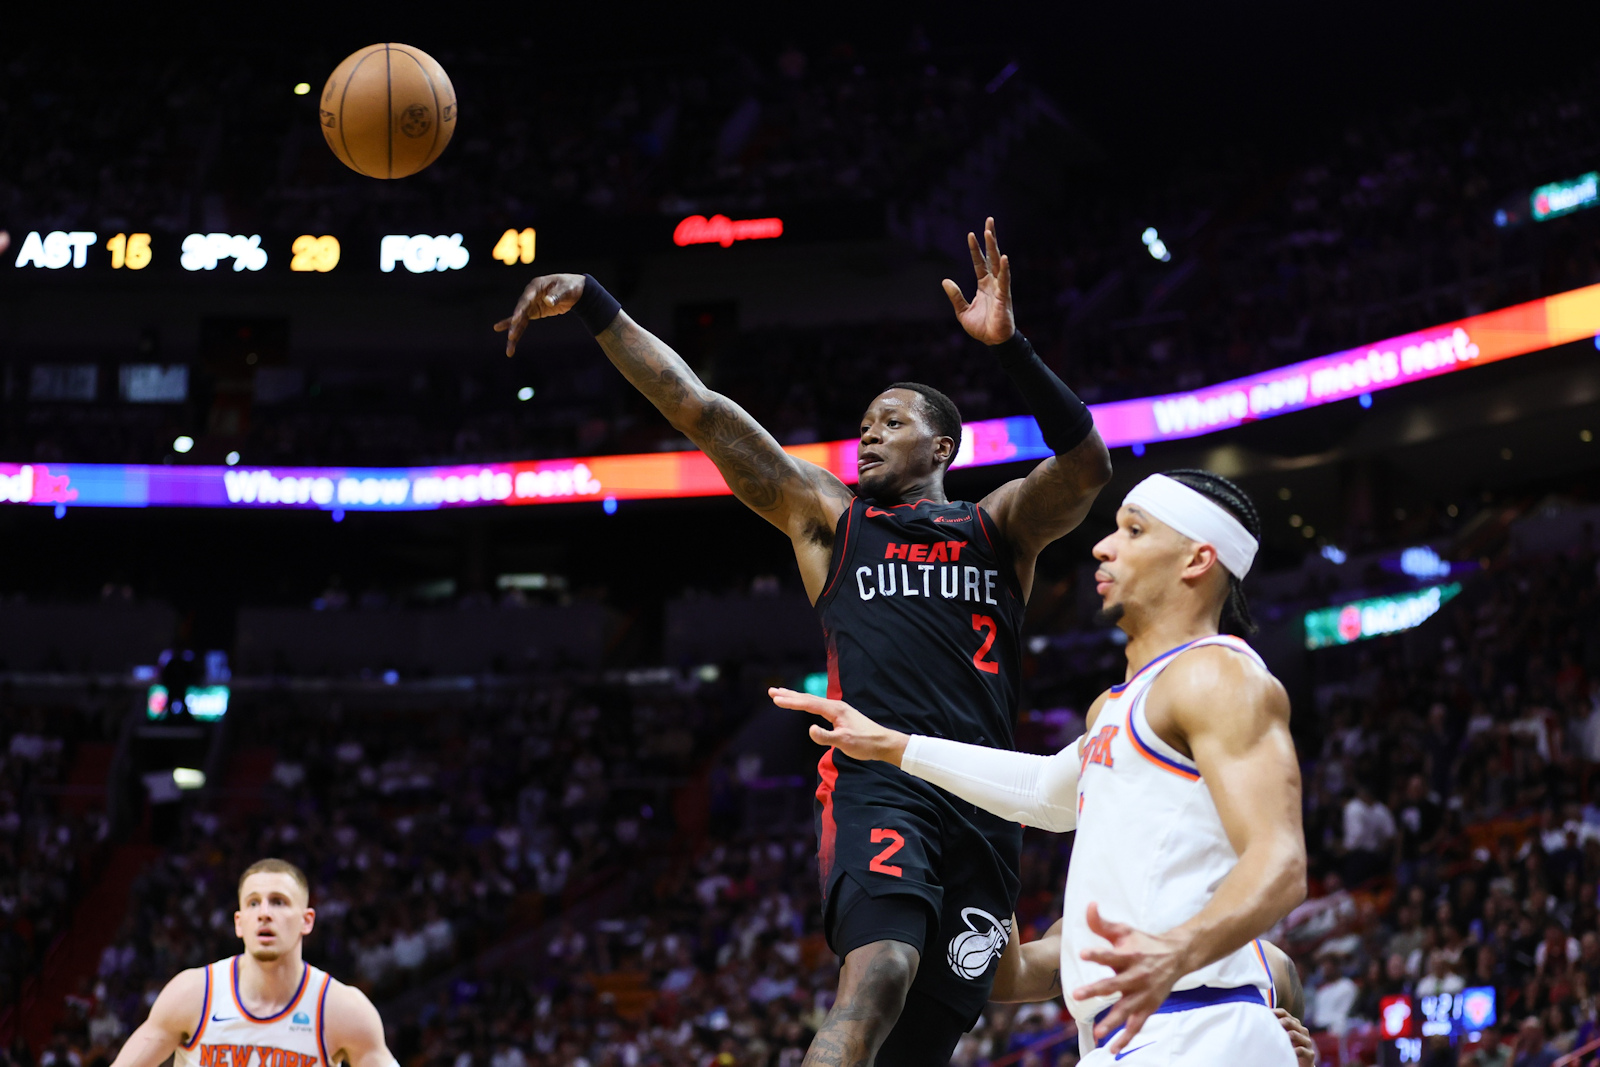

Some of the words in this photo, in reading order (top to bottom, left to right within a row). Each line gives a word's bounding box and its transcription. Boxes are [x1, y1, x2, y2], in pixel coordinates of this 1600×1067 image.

[15, 231, 97, 269] AST
[106, 233, 152, 270] 15
[380, 233, 470, 273] FG%
[492, 227, 536, 265] 41
[1153, 391, 1249, 434] Where
[1249, 374, 1309, 414] now
[1310, 350, 1400, 398] meets
[223, 470, 334, 504] Where
[338, 477, 410, 504] now
[412, 468, 513, 503] meets
[515, 463, 601, 498] next.
[884, 540, 968, 563] HEAT
[855, 563, 998, 606] CULTURE
[971, 613, 999, 675] 2
[869, 828, 905, 878] 2
[200, 1043, 253, 1067] NEW
[256, 1045, 317, 1067] YORK
